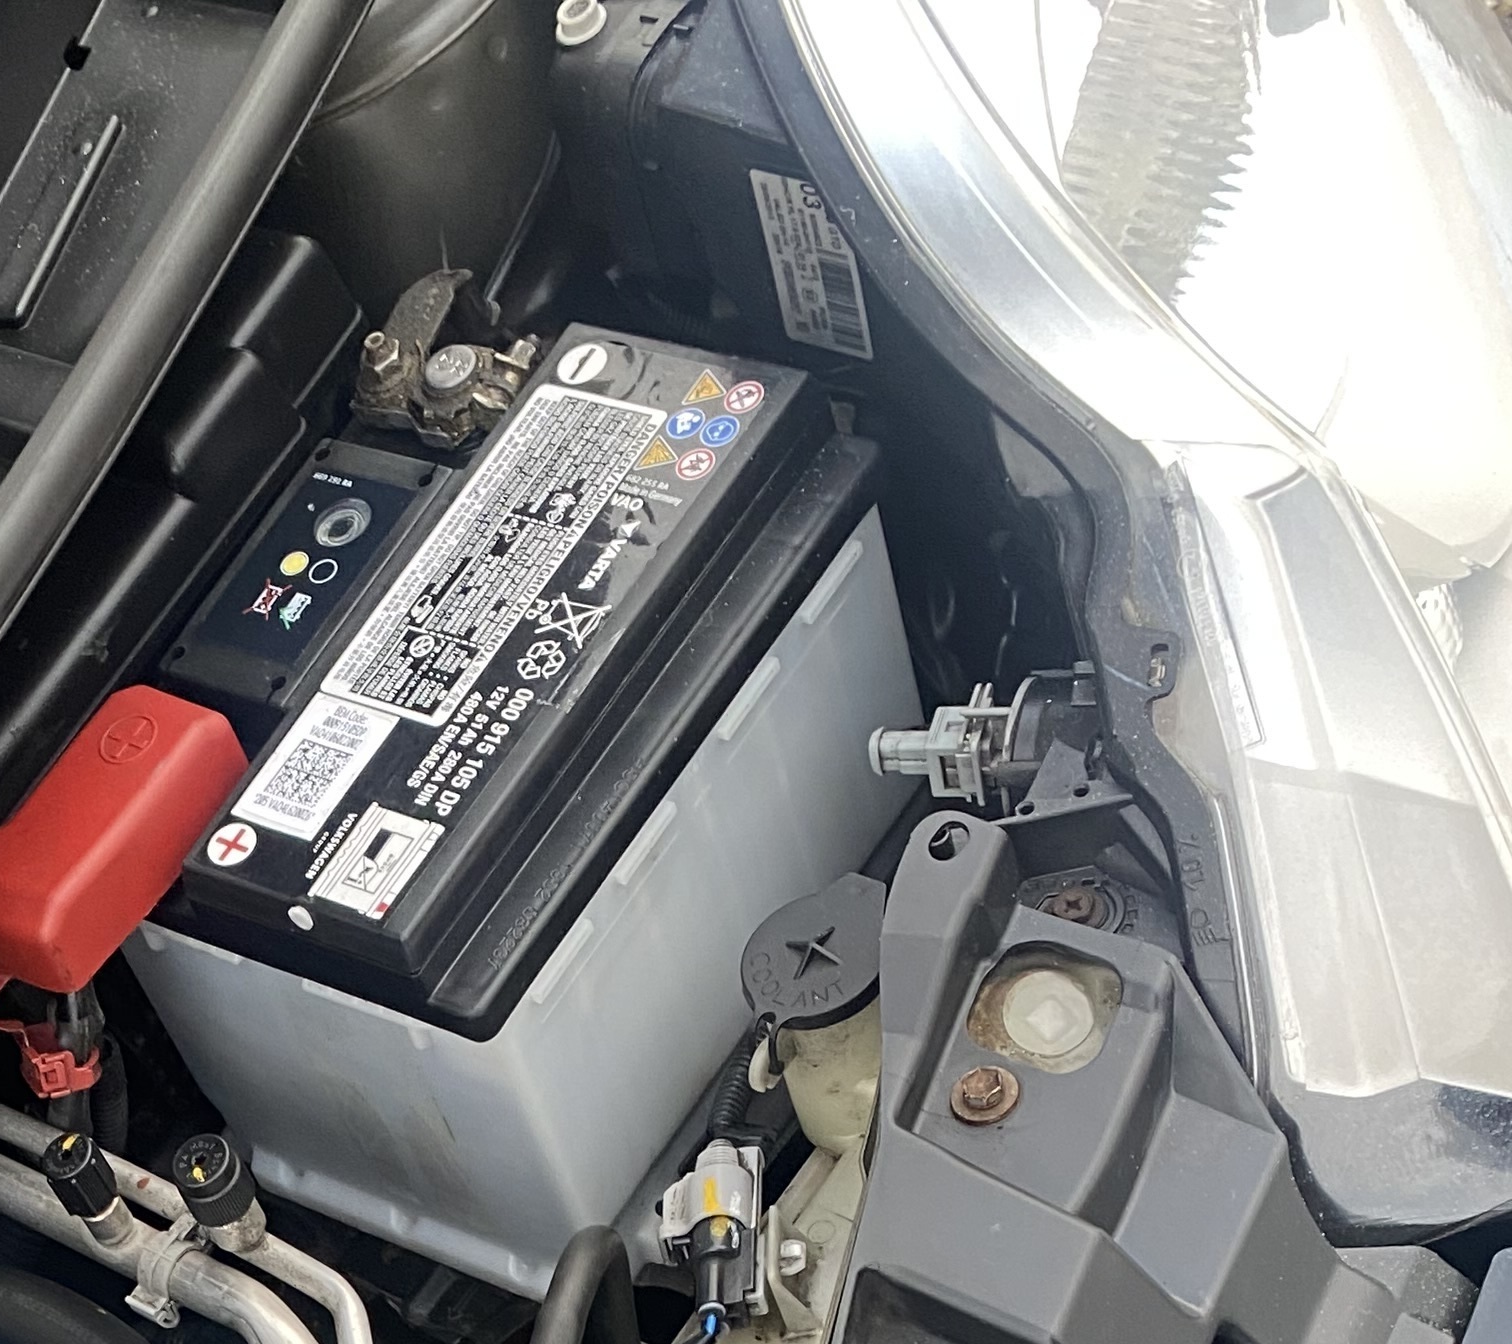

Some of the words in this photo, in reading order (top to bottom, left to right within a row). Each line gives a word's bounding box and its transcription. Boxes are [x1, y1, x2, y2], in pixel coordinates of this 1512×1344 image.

[576, 533, 627, 595] VARTA
[524, 595, 550, 624] Pb
[452, 688, 484, 727] 480A
[484, 681, 510, 711] 12V
[499, 683, 535, 724] 000
[404, 720, 461, 792] EN/SAE/GS
[474, 717, 510, 759] 915
[430, 746, 463, 785] 280A
[449, 751, 485, 793] 105
[412, 779, 439, 809] DIN
[430, 786, 460, 819] DP
[303, 810, 358, 881] VOLKSWAGEN
[750, 952, 845, 1009] COOLANT
